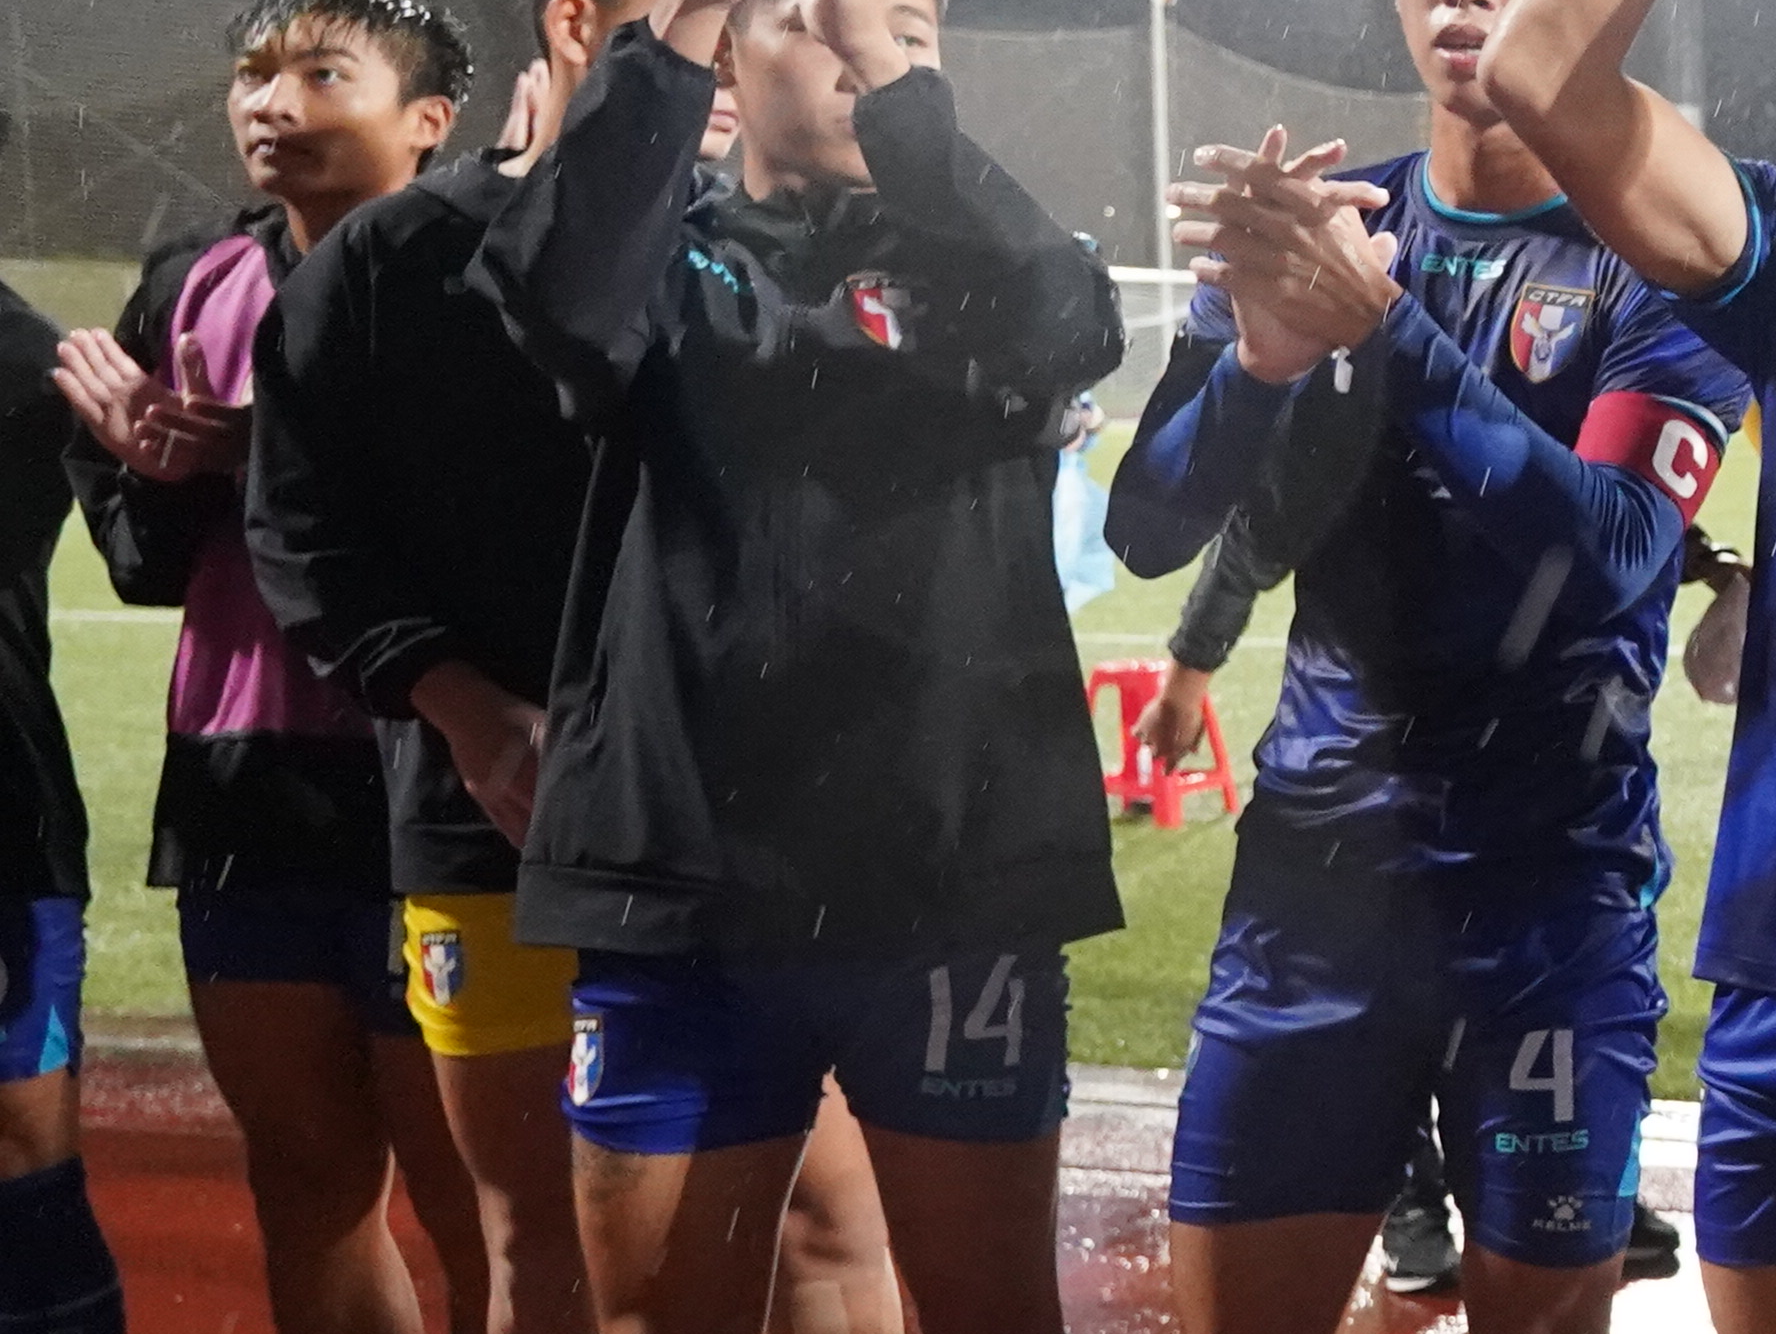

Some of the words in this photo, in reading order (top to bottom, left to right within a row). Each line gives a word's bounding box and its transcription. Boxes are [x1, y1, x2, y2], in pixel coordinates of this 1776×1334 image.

[1652, 419, 1708, 499] C
[925, 954, 1026, 1073] 14
[1509, 1029, 1574, 1122] 4
[1495, 1129, 1590, 1153] ENTES
